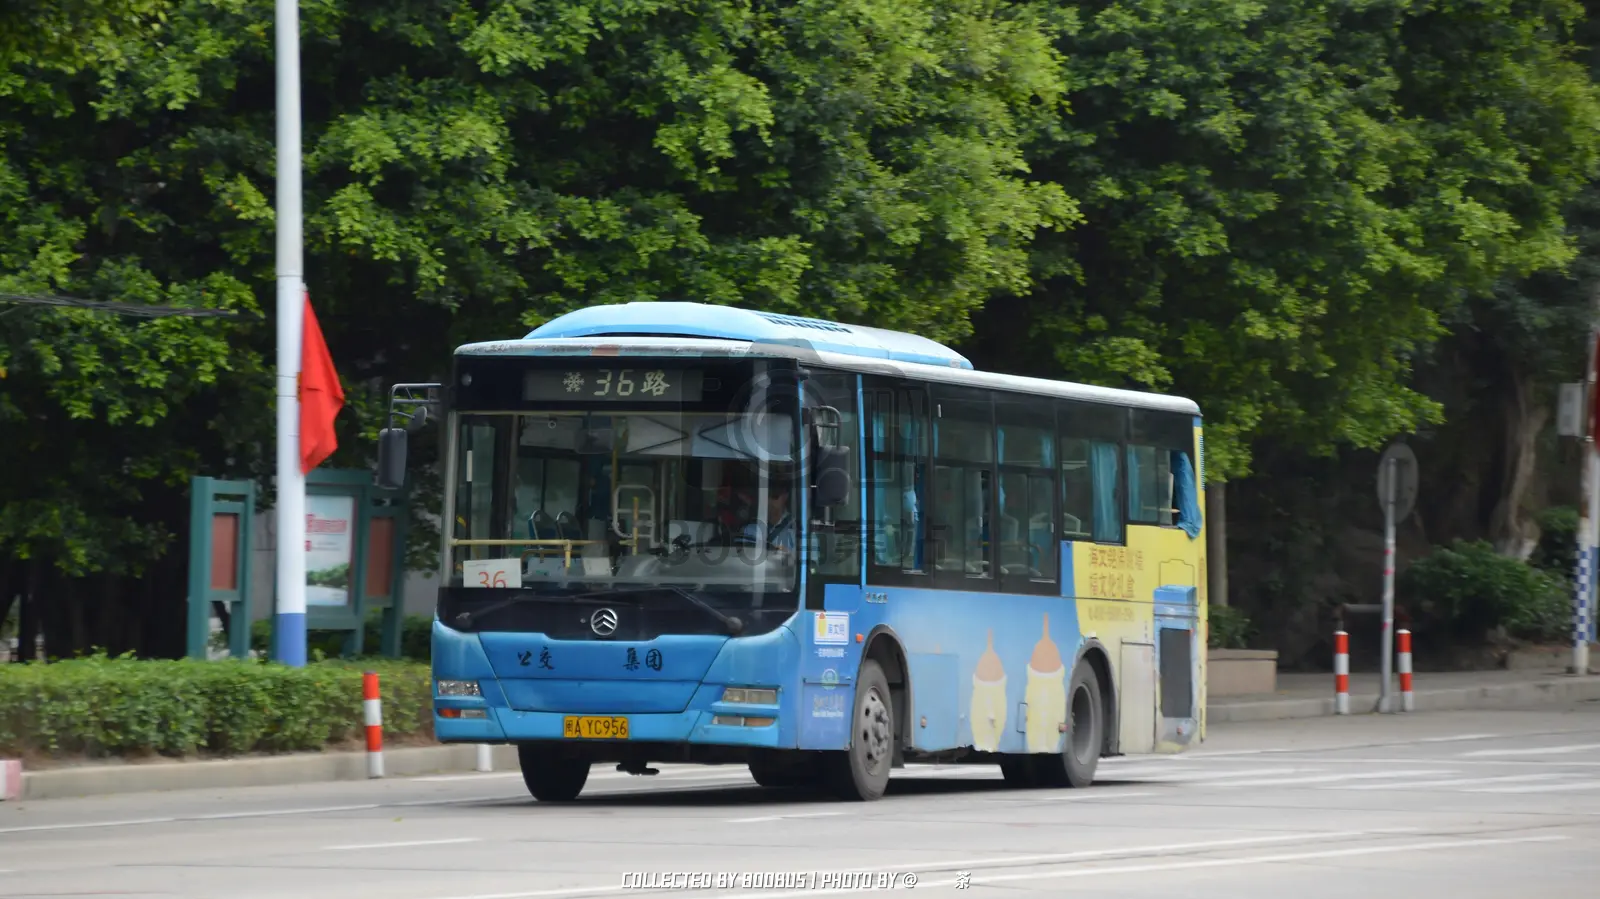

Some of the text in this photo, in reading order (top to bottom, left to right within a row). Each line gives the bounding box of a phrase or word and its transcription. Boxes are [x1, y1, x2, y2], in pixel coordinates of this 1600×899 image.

[594, 369, 670, 396] 36路
[478, 570, 506, 588] 36
[517, 646, 663, 671] 公交 集团
